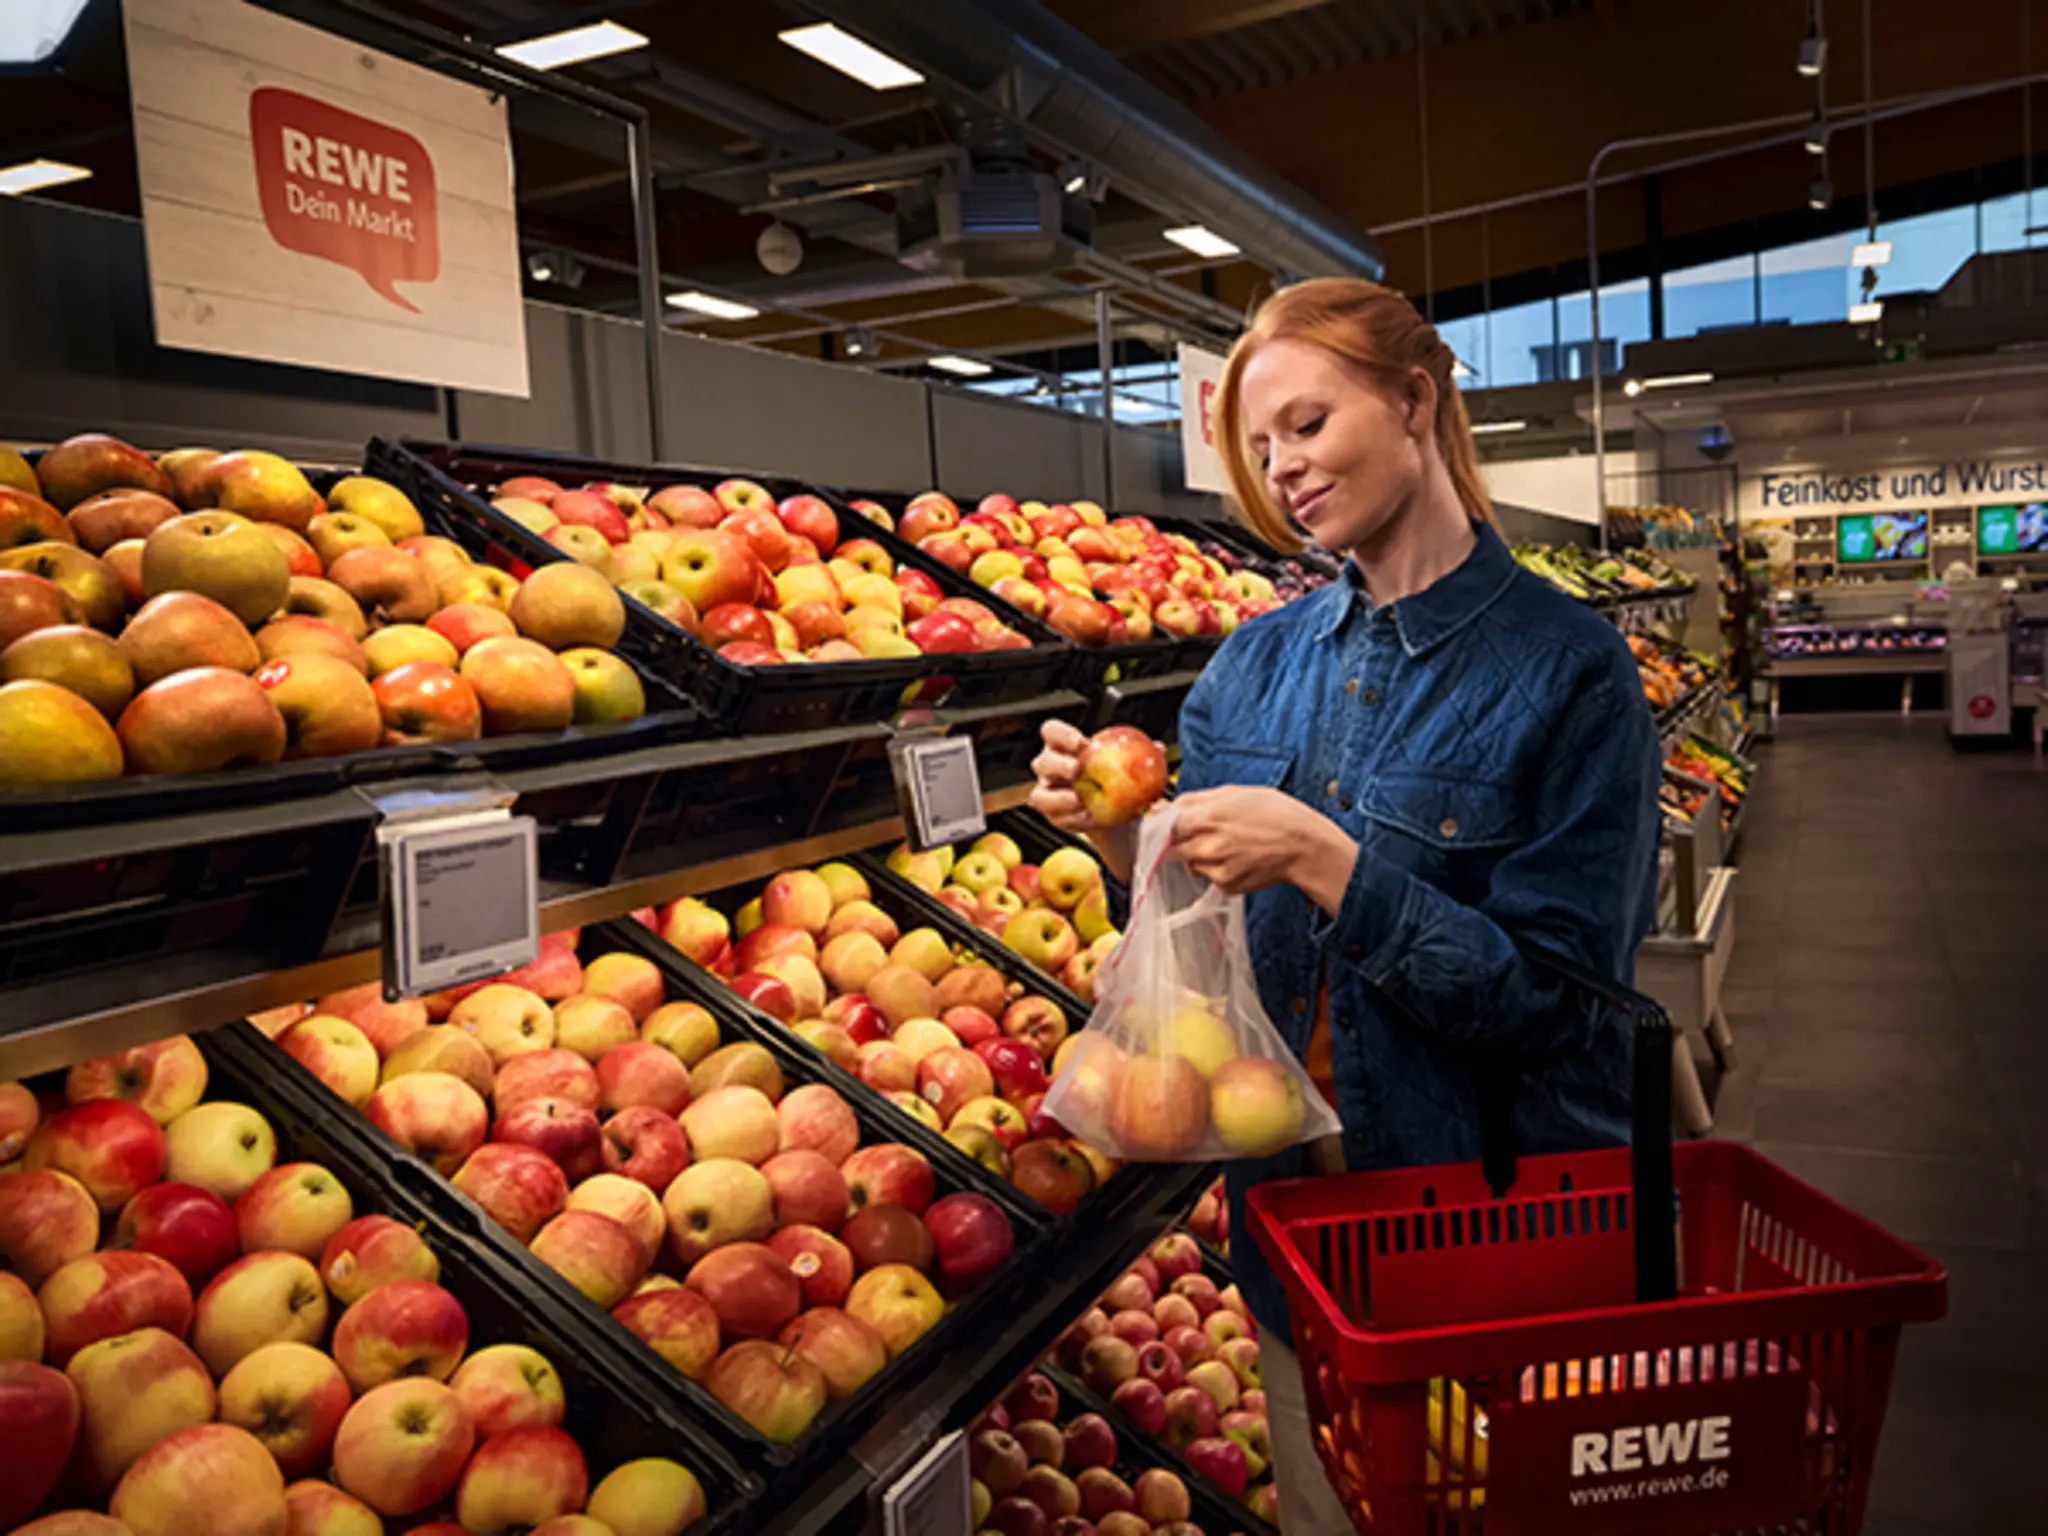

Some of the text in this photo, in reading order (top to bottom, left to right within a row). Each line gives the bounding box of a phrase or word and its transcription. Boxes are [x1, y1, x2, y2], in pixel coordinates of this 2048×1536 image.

[282, 126, 411, 203] REWE
[285, 181, 416, 243] Dein Markt
[1761, 461, 2046, 507] Feinkost und Wurst
[1570, 1415, 1732, 1477] REWE
[1569, 1465, 1730, 1507] www.rewe.de
